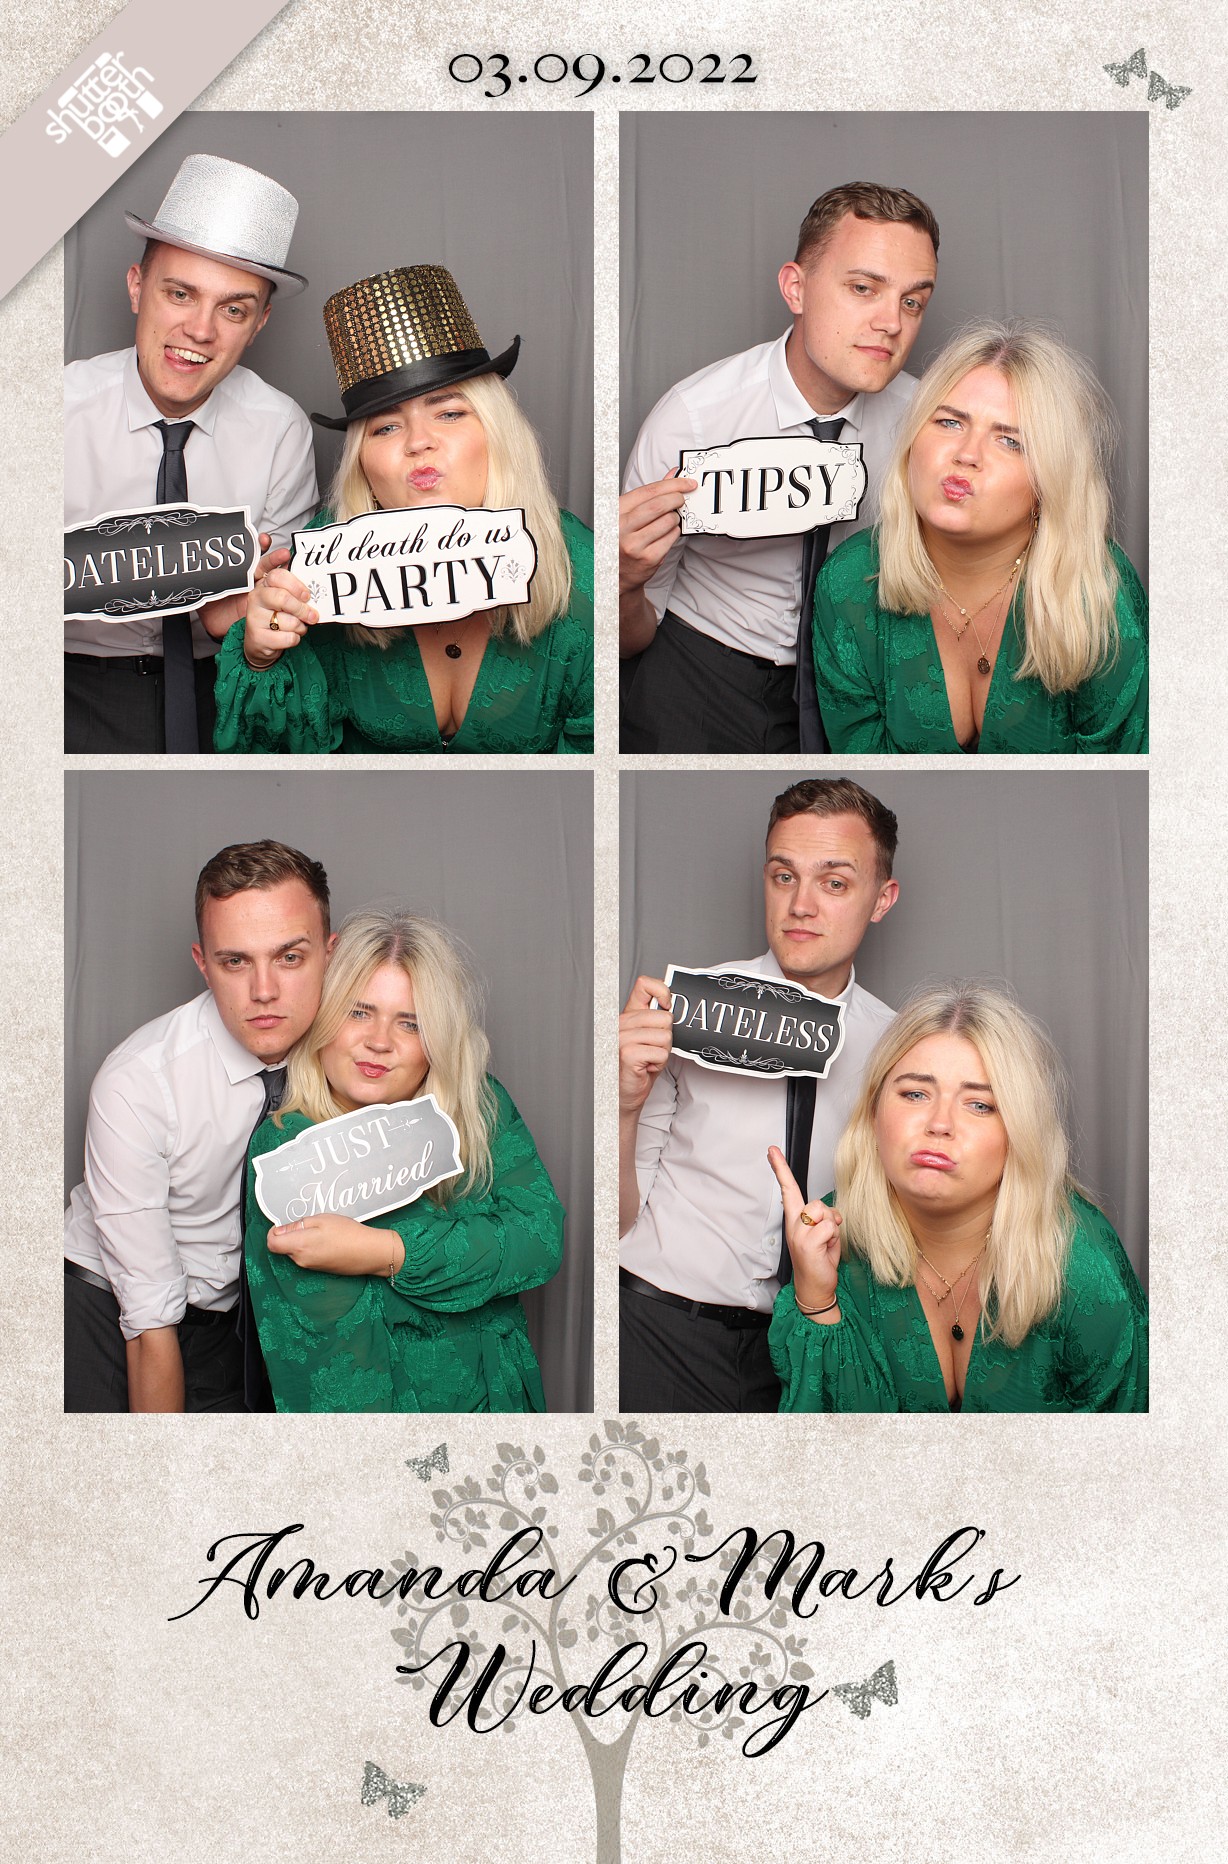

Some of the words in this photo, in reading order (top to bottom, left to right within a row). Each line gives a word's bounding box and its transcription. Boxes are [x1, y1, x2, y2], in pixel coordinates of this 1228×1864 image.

[702, 462, 846, 515] TIPSY
[348, 523, 429, 562] death
[438, 518, 476, 551] do
[485, 524, 519, 545] us
[327, 555, 506, 616] PARTY
[668, 992, 835, 1053] DATELESS
[310, 1115, 392, 1175] JUST
[285, 1140, 434, 1222] Married
